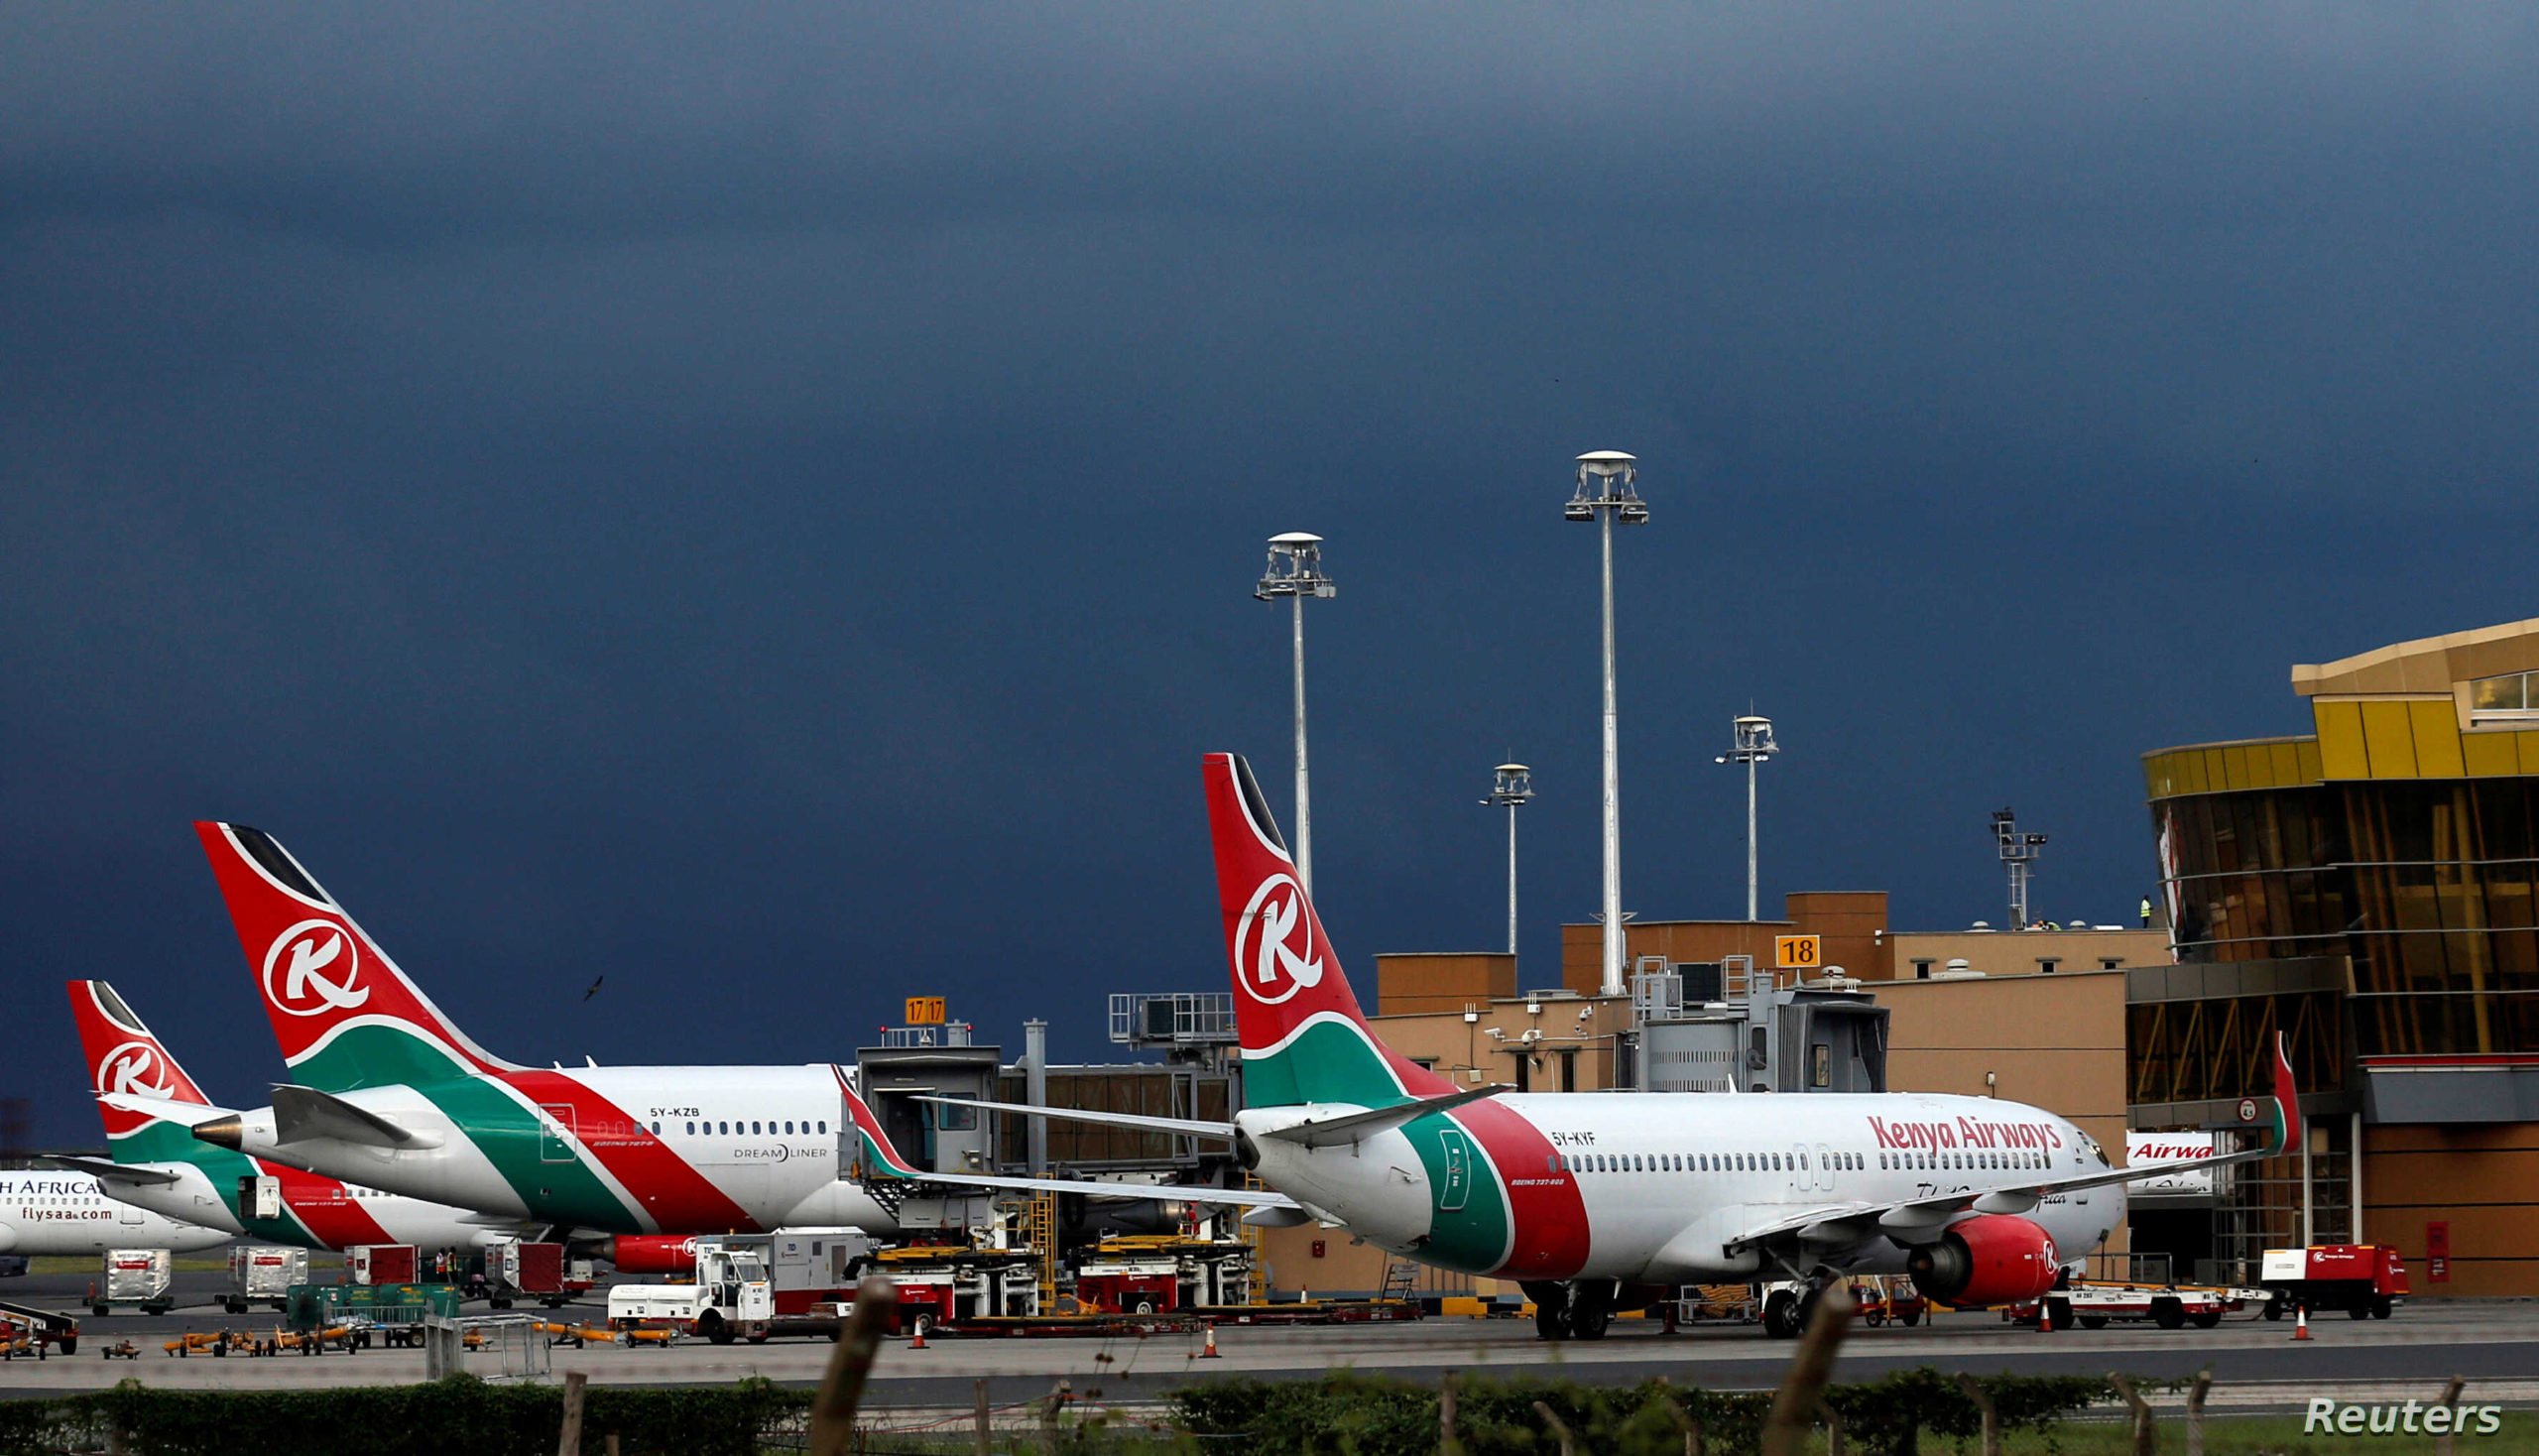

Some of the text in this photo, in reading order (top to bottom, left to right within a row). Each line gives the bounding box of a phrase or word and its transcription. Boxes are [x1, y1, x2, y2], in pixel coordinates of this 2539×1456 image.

[1782, 939, 1814, 963] 18
[908, 1000, 923, 1022] 17
[928, 1000, 942, 1021] 17
[650, 1107, 700, 1118] 5Y-KZB
[1551, 1131, 1596, 1147] 5Y-KYF
[1867, 1116, 2063, 1158] Kenya Airways
[734, 1147, 828, 1160] DREAMLINER
[2133, 1143, 2214, 1159] Airwa
[22, 1207, 112, 1222] flysaa.com
